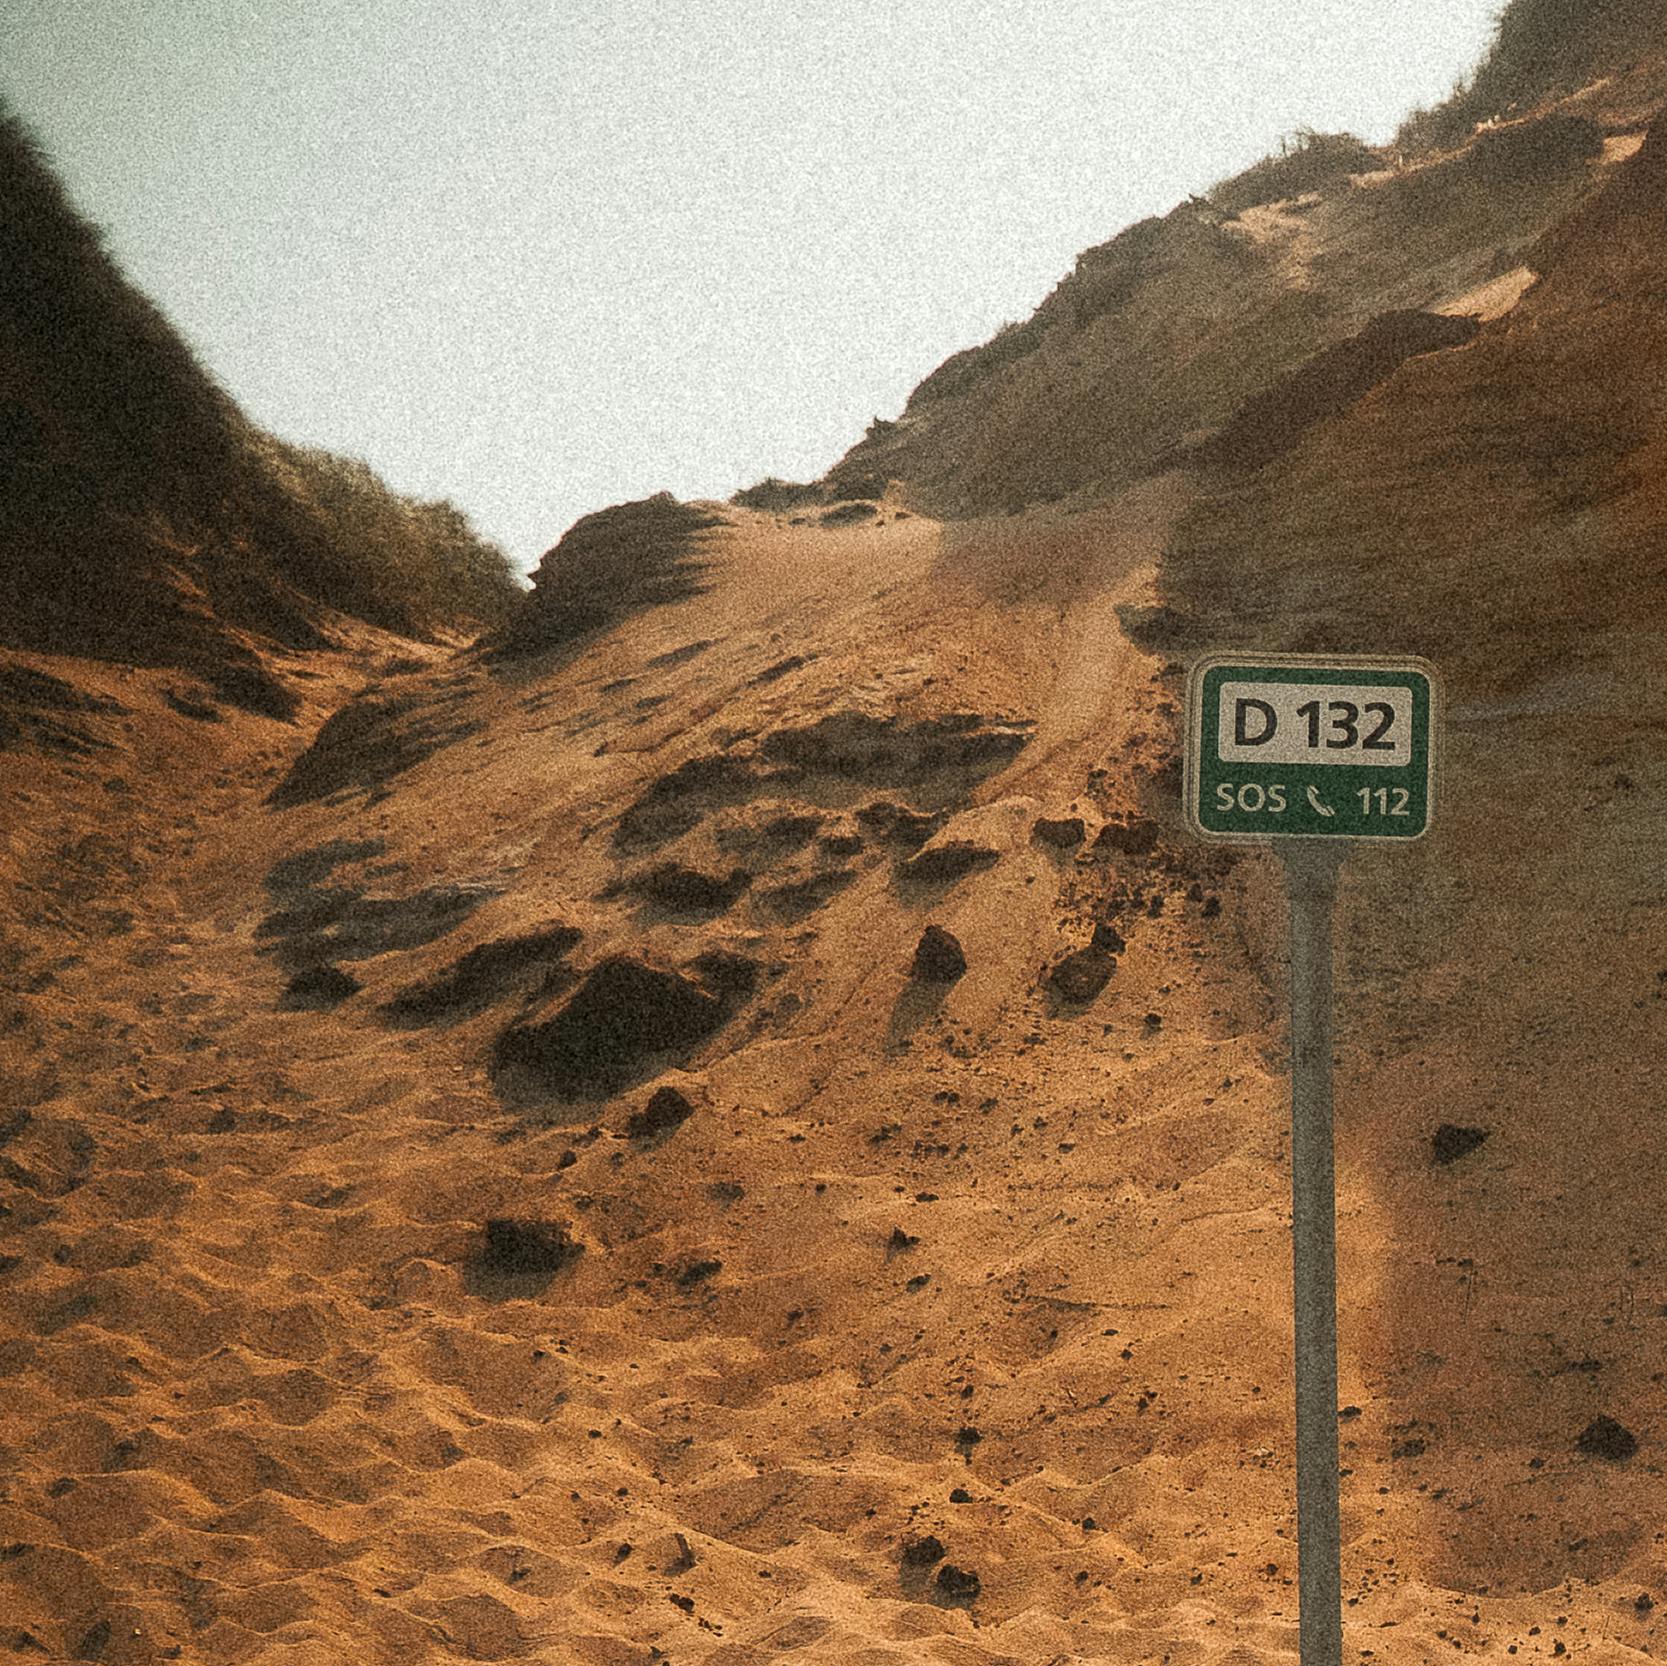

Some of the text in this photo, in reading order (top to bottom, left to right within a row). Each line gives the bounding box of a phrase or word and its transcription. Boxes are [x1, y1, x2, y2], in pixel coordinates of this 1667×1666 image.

[1235, 698, 1396, 750] D 132
[1215, 783, 1410, 816] SOS 112
